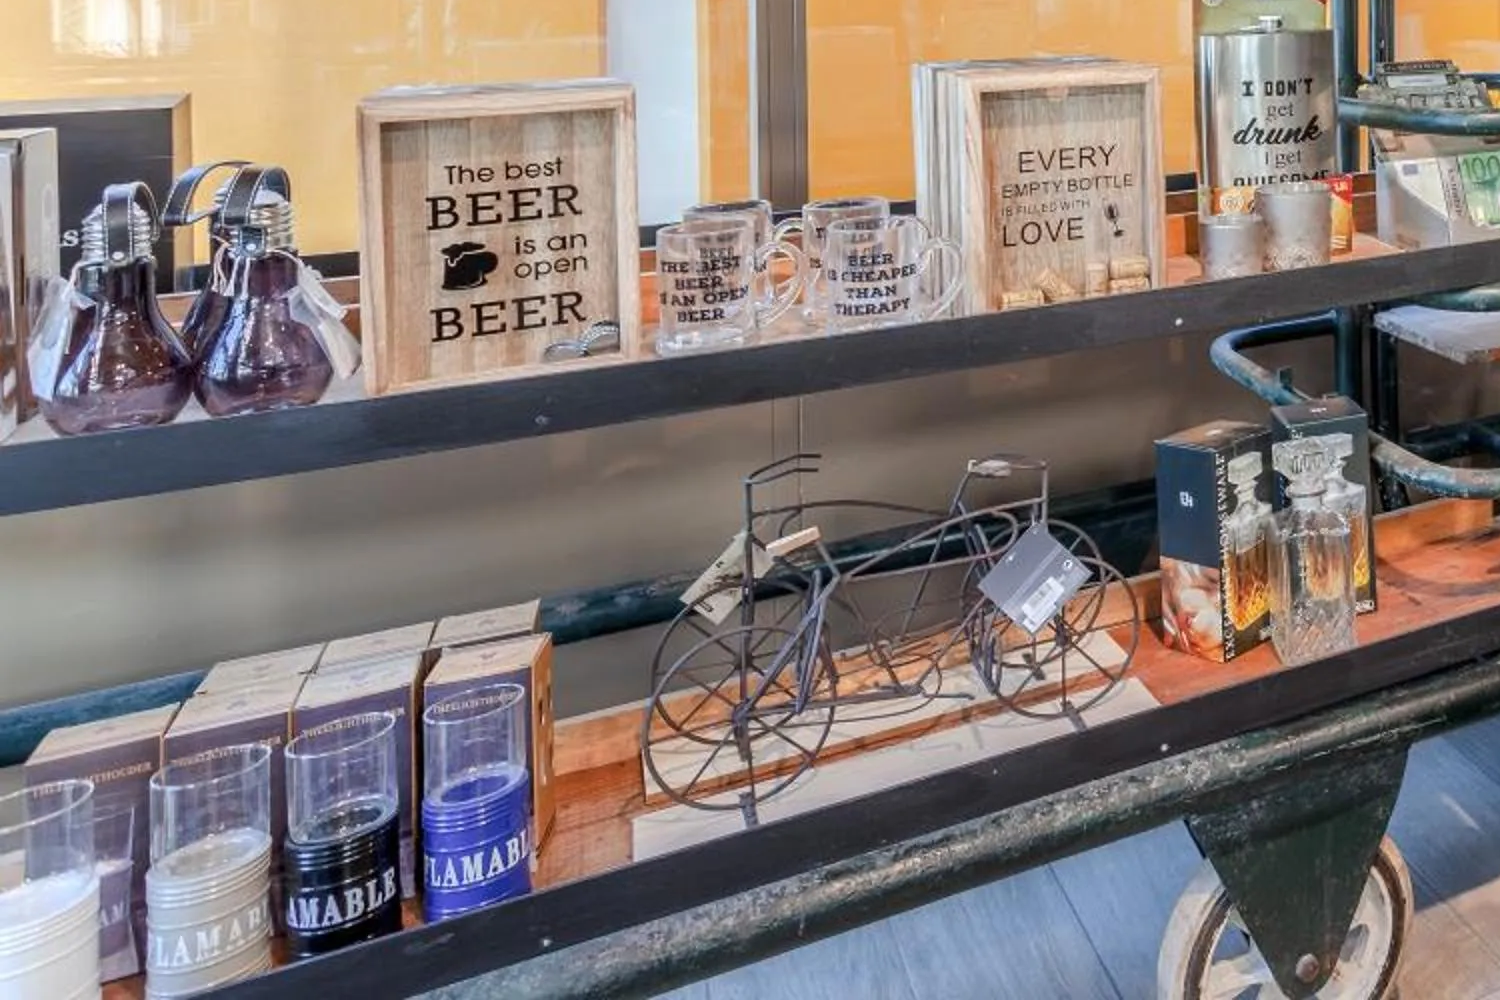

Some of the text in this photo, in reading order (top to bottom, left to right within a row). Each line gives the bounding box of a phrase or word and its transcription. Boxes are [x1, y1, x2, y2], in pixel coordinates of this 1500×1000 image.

[1241, 78, 1314, 98] I DON'T
[1266, 103, 1295, 121] get
[1232, 115, 1325, 146] drunk
[1018, 144, 1117, 174] EVERY
[1274, 149, 1304, 169] get
[444, 157, 563, 185] The best
[1002, 172, 1134, 200] EMPTY BOTTLE
[425, 184, 583, 231] BEER
[1016, 202, 1058, 216] FILLED
[1059, 198, 1091, 212] WITH
[1003, 217, 1085, 247] LOVE
[514, 233, 588, 255] is an
[514, 255, 588, 281] open
[661, 255, 741, 274] THE BEST
[848, 253, 894, 267] BEER
[841, 263, 917, 283] CHEAPER
[671, 294, 696, 306] AN
[703, 284, 749, 305] OPEN
[845, 284, 897, 299] THAN
[429, 291, 587, 343] BEER
[677, 307, 725, 322] BEER
[835, 297, 911, 317] THERAPY
